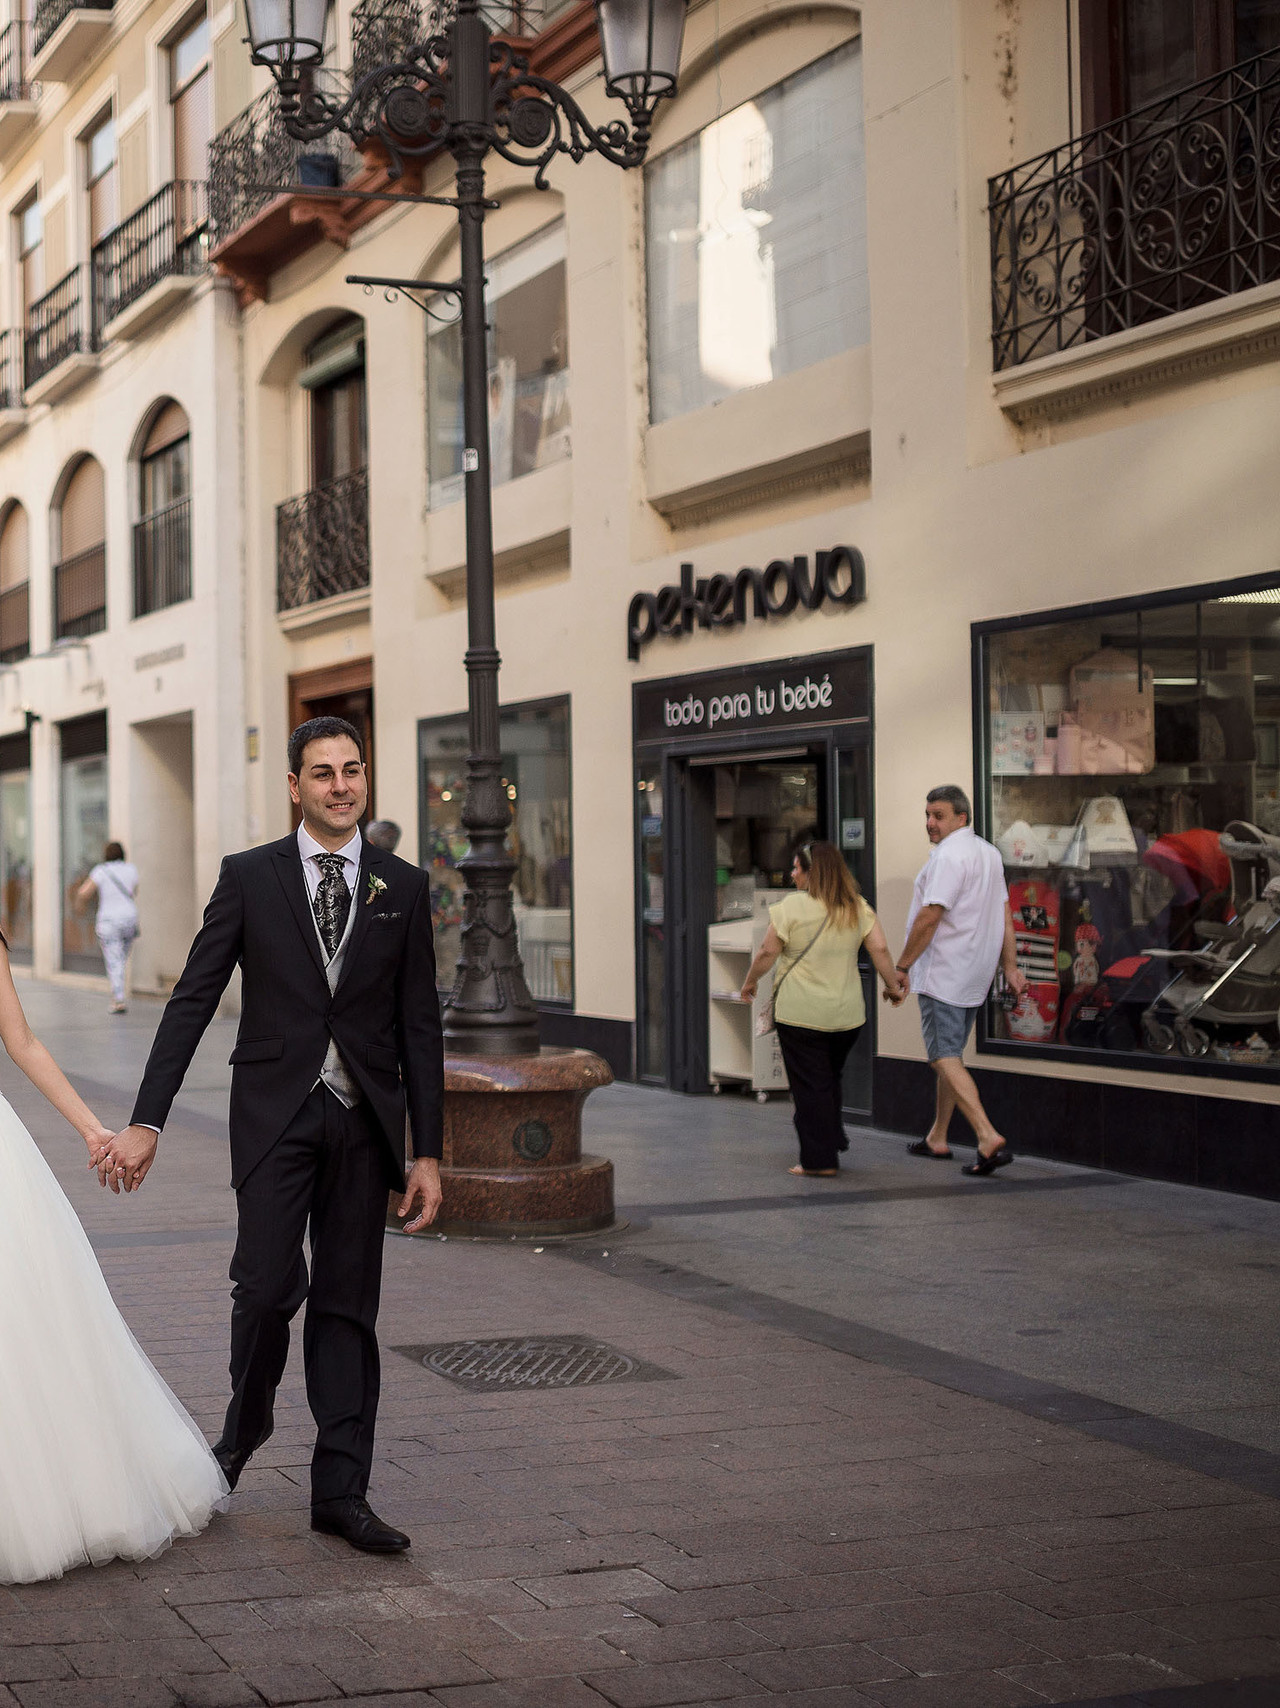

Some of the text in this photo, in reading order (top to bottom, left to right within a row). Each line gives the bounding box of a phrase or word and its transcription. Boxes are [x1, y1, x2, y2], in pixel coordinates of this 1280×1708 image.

[627, 545, 867, 662] pekenova
[664, 673, 833, 729] todo para tu bebé
